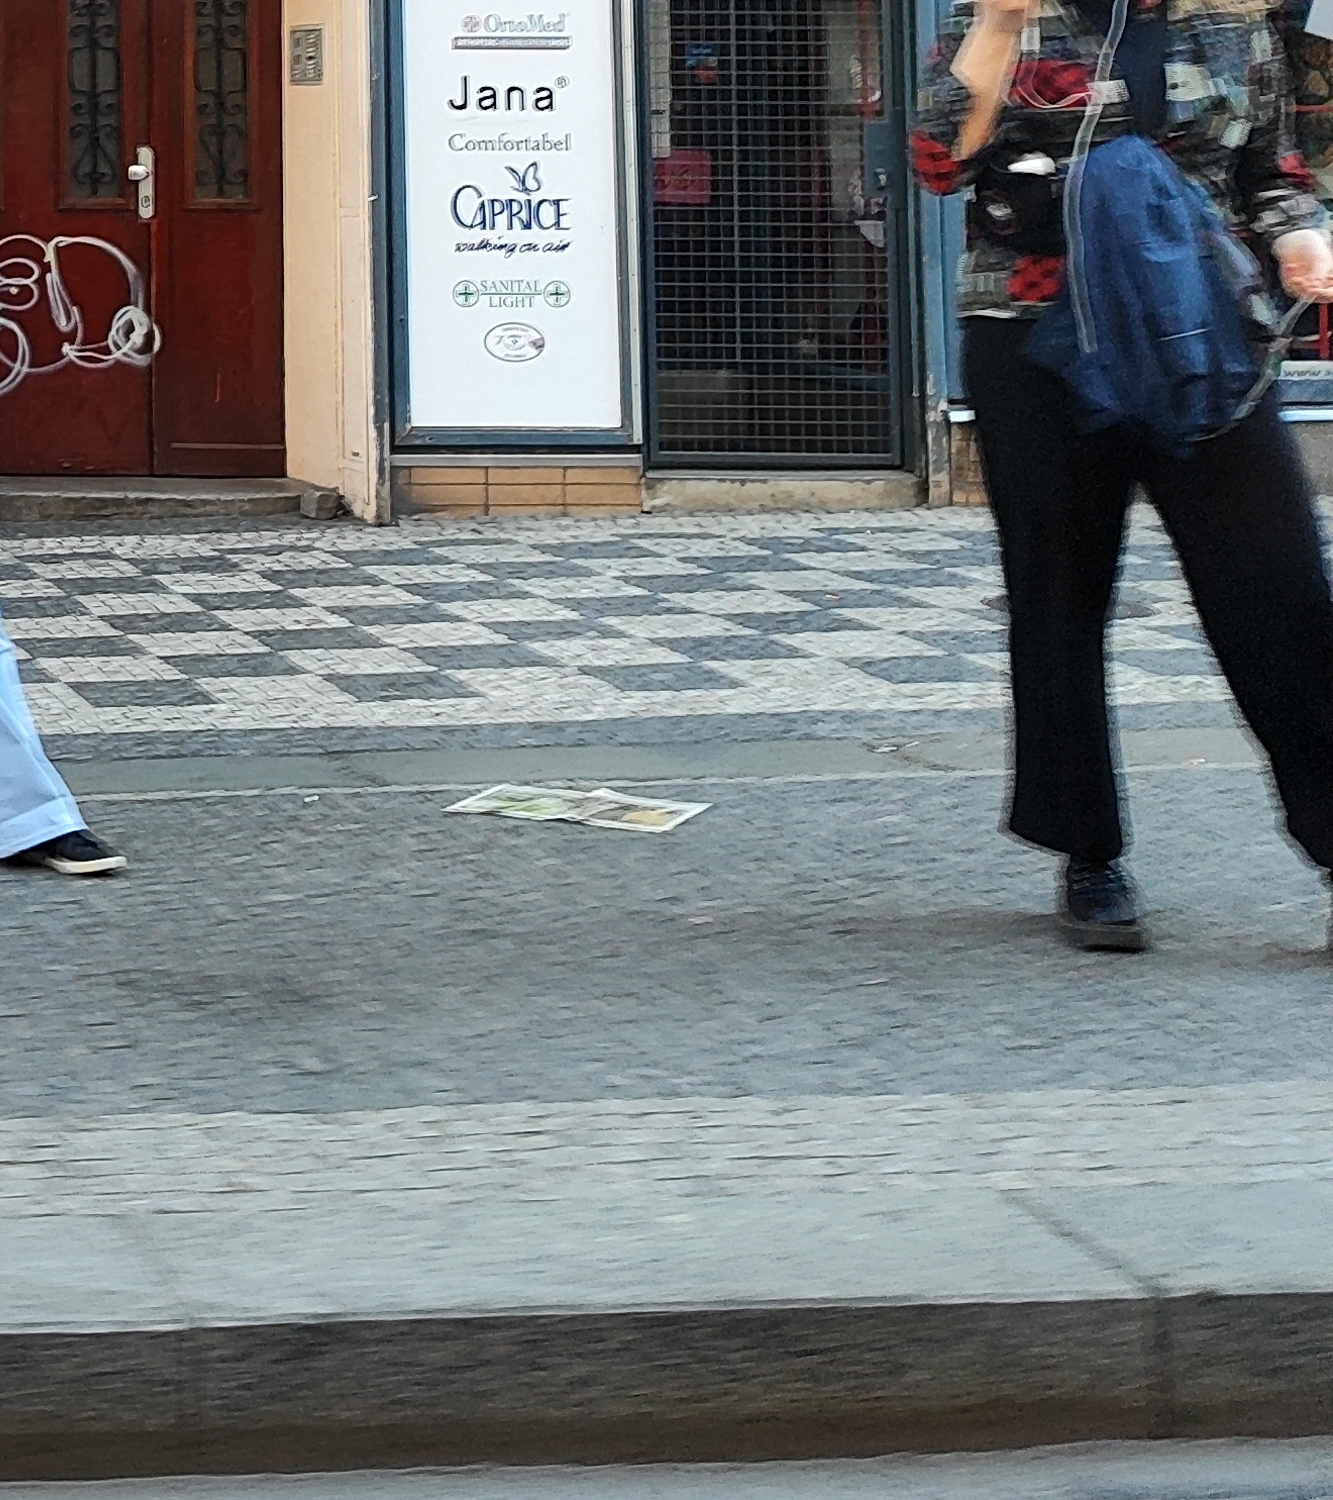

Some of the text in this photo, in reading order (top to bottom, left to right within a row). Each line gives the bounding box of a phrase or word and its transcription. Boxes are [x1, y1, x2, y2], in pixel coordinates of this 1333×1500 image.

[448, 132, 572, 152] Comfortabel
[455, 235, 517, 259] walking
[480, 280, 542, 293] SANITAL
[488, 296, 536, 309] LIGHT
